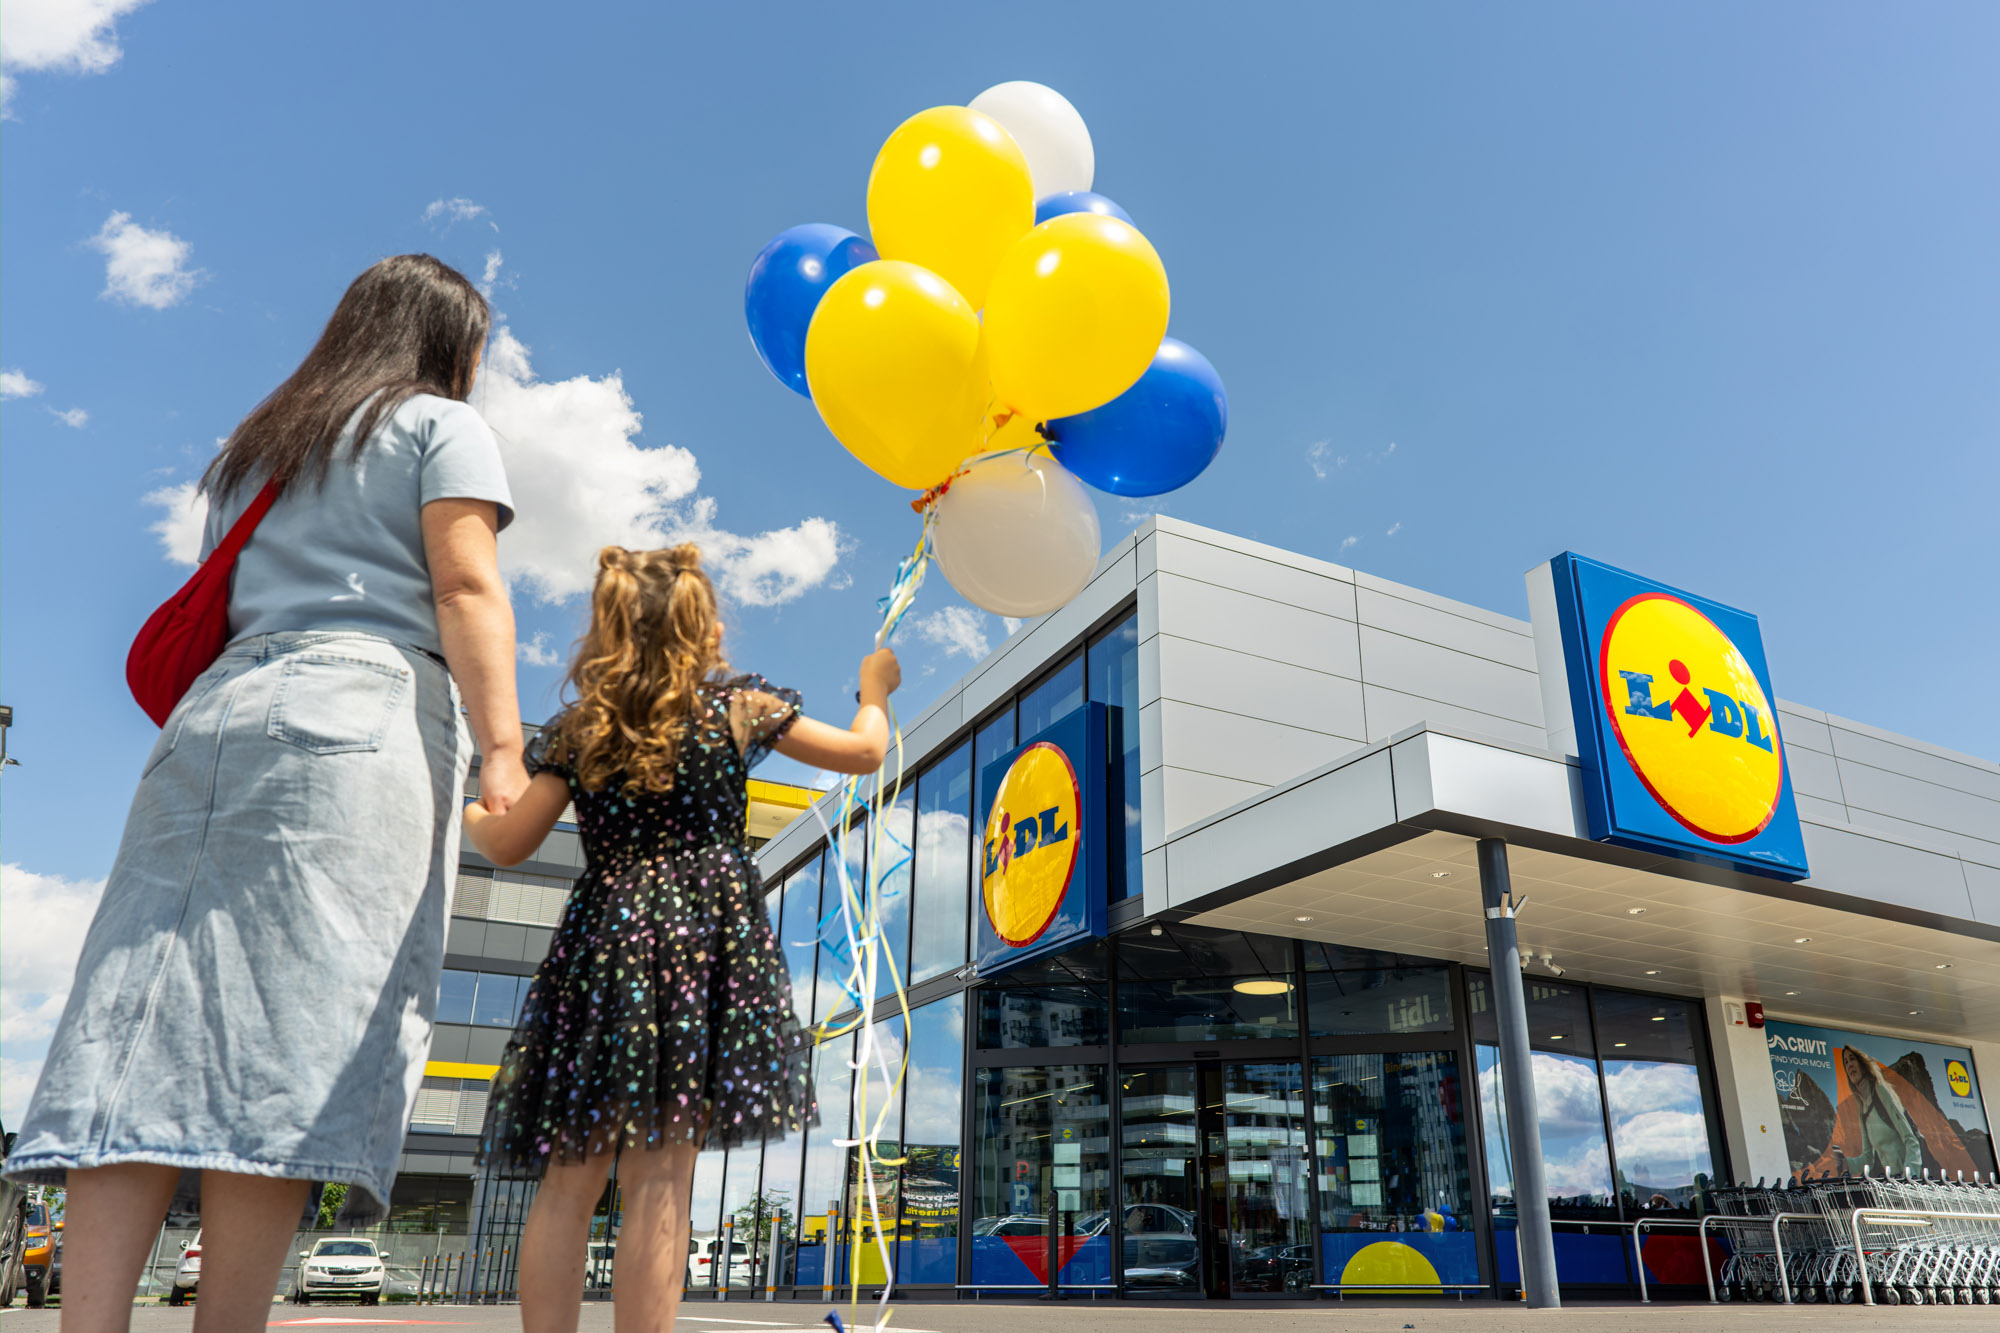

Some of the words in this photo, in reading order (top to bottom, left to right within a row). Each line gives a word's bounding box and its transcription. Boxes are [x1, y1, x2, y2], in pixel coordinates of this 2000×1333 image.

[1388, 994, 1439, 1031] Lidl.
[1788, 1037, 1827, 1056] CRIVIT
[1770, 1055, 1788, 1064] FIND
[1788, 1056, 1809, 1066] YOUR
[1809, 1060, 1831, 1069] MOVE
